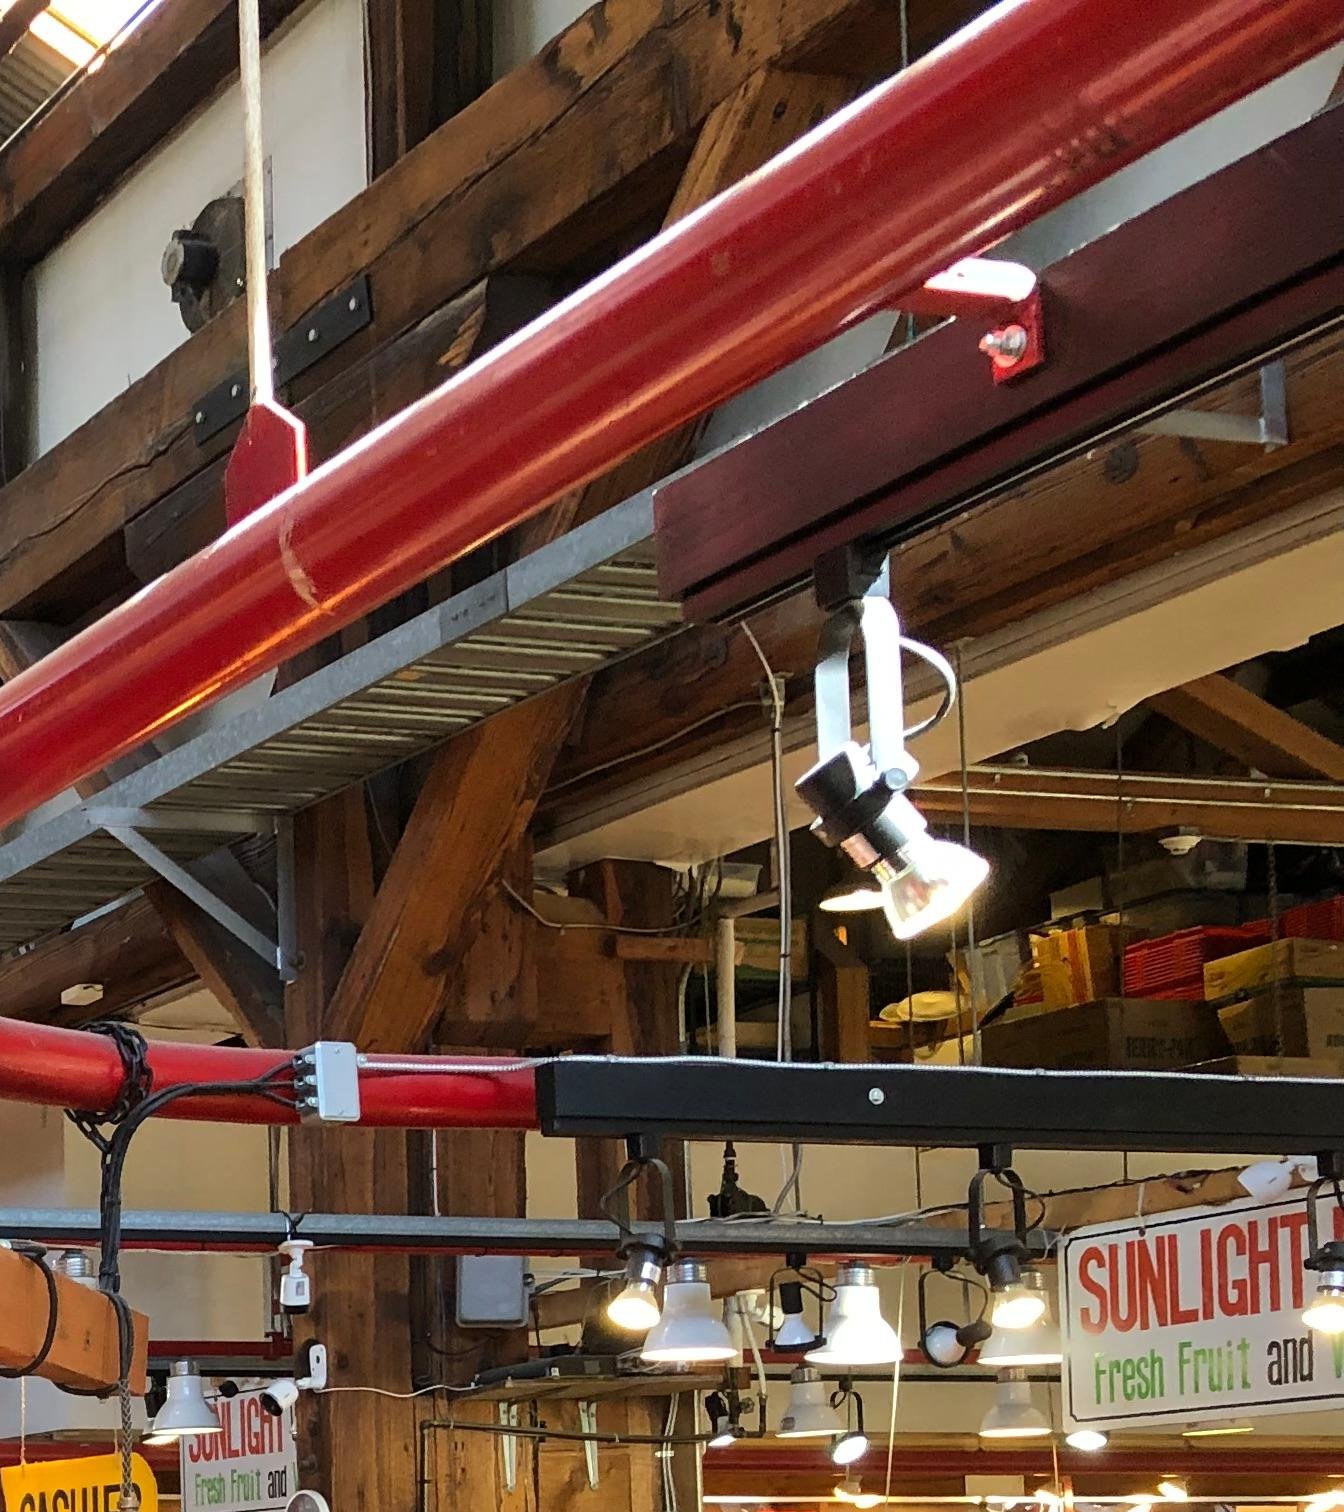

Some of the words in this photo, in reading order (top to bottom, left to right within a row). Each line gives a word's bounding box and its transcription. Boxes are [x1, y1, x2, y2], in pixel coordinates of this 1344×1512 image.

[1078, 1211, 1309, 1336] SUNLIGHT
[1094, 1348, 1165, 1405] Fresh
[1178, 1337, 1252, 1396] Fruit
[1267, 1330, 1314, 1386] and
[195, 1472, 226, 1506] Fresh
[230, 1468, 262, 1503] Fruit
[268, 1465, 288, 1499] and
